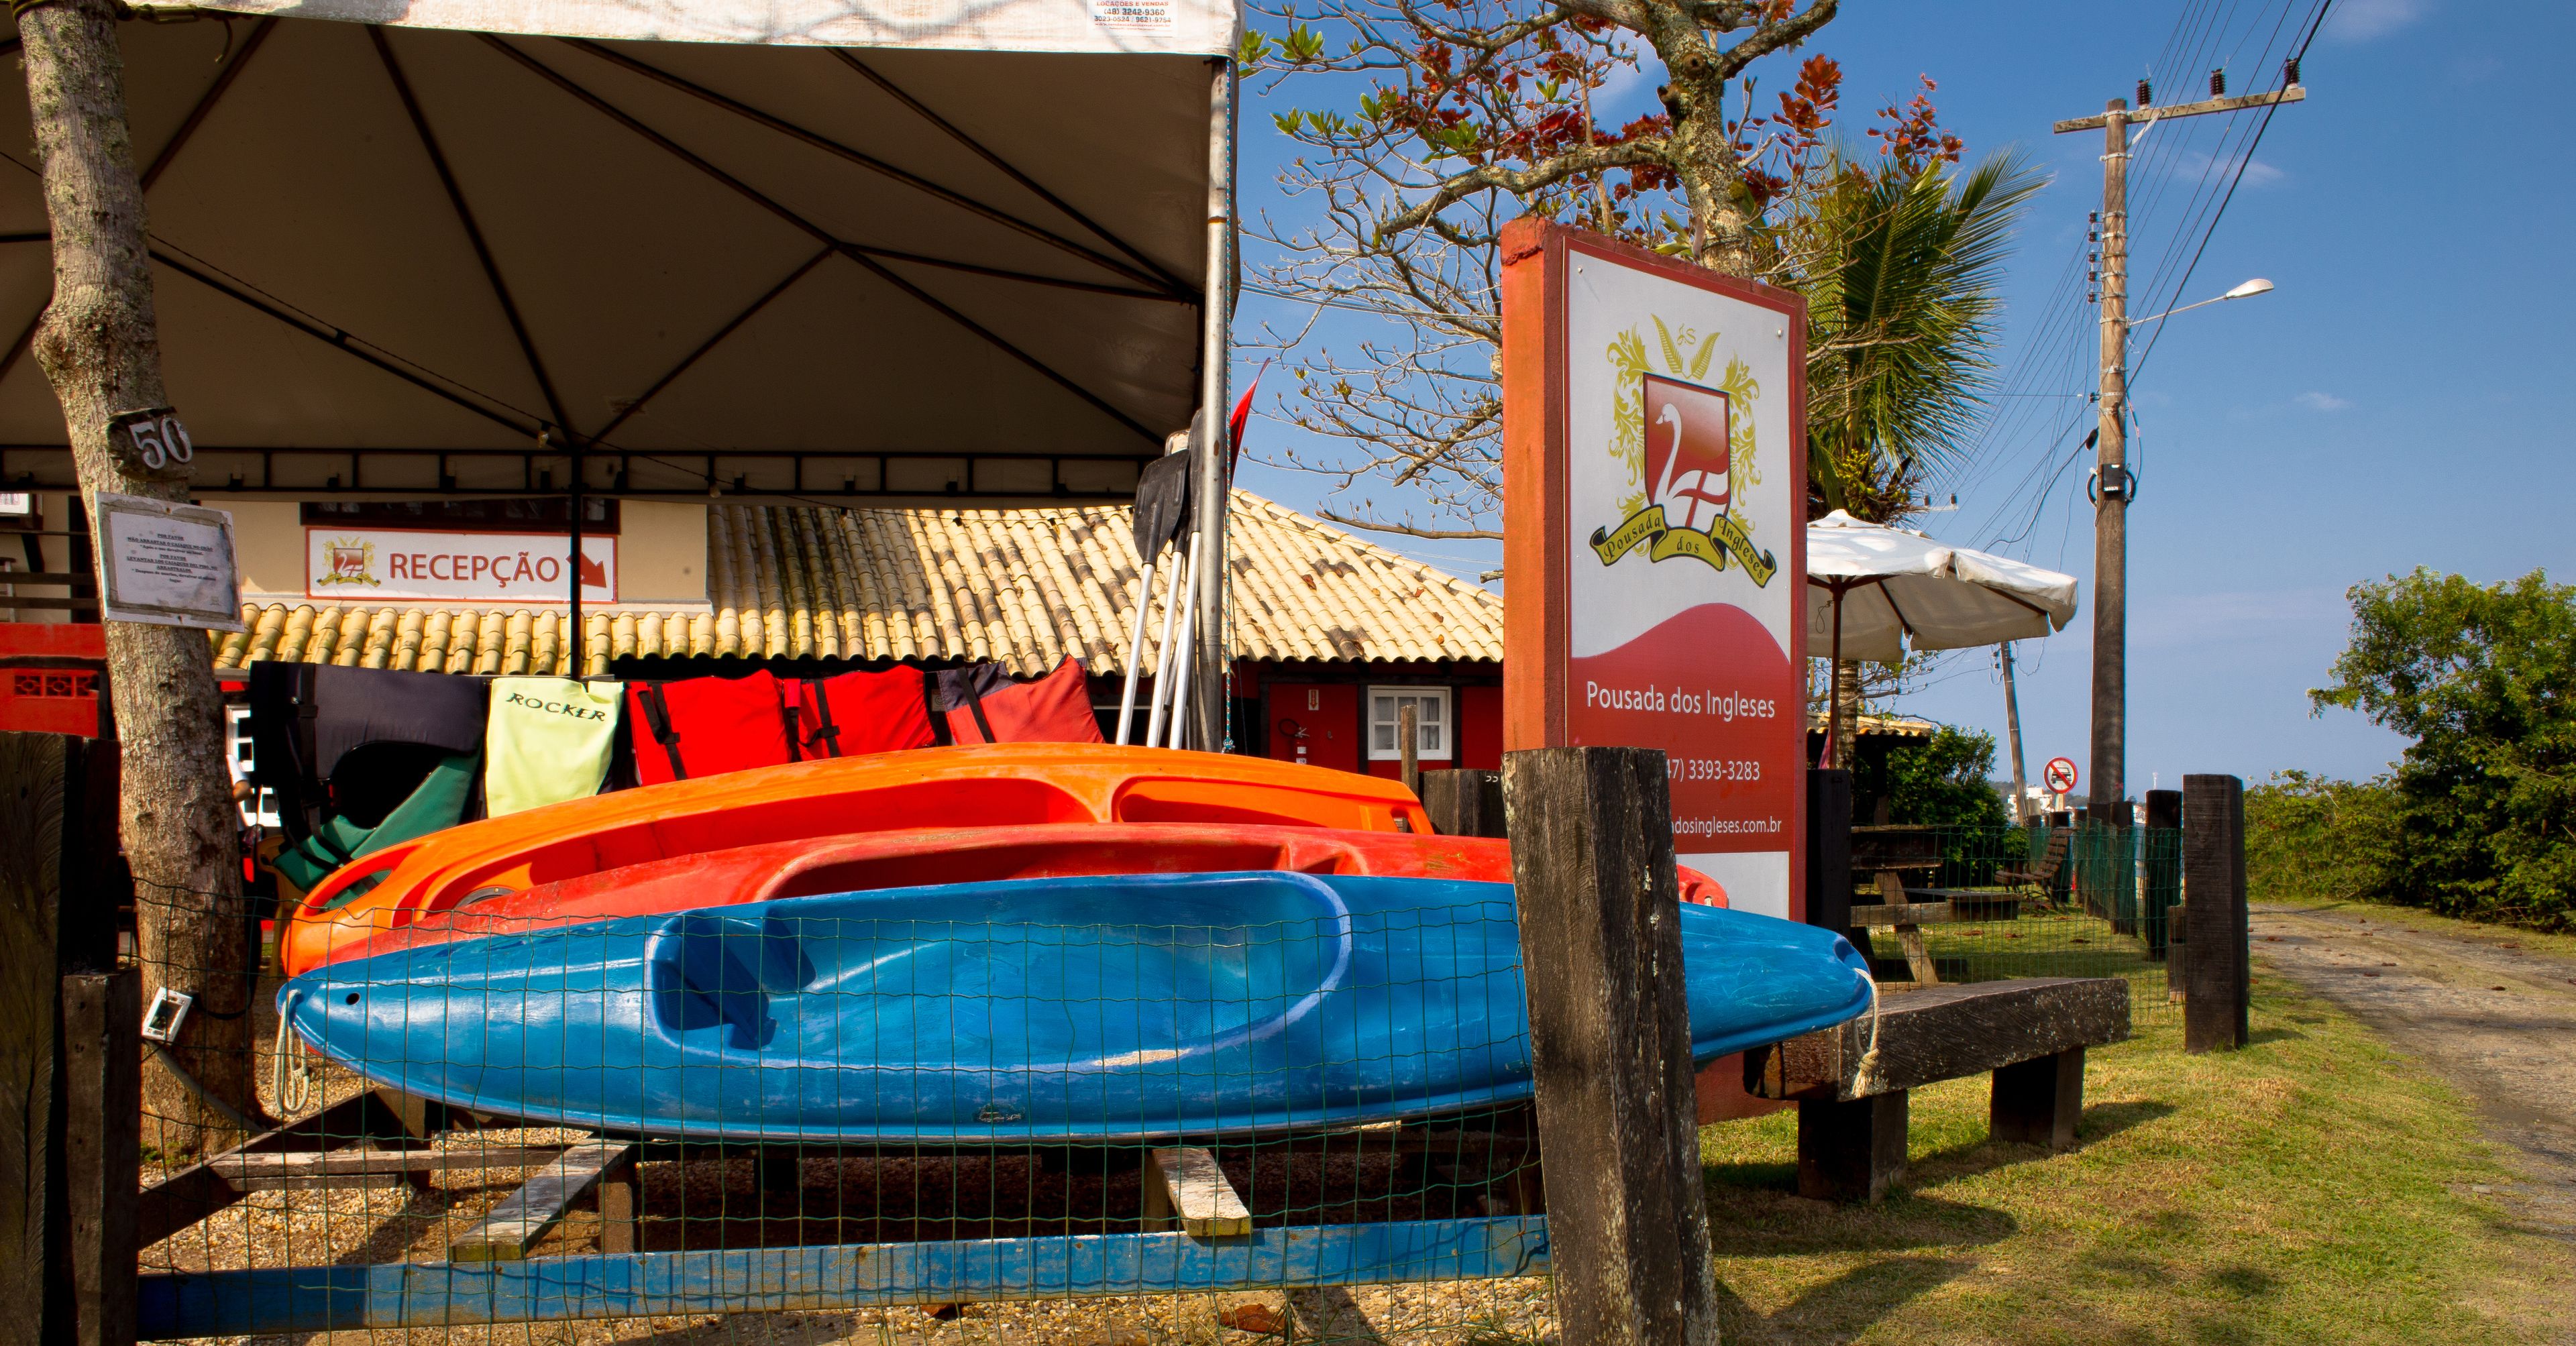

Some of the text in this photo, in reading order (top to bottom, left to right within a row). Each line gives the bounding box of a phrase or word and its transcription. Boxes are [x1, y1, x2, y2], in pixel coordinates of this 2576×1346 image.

[128, 416, 193, 469] 50
[1603, 514, 1764, 579] Pousada dos Ingleses
[388, 551, 560, 588] RECEPÇÃO
[506, 692, 606, 722] ROCKER
[1587, 681, 1775, 722] Pousada dos Ingleses
[1688, 759, 1760, 781] 3393-3283
[1672, 816, 1782, 838] dosingleses.com.br
